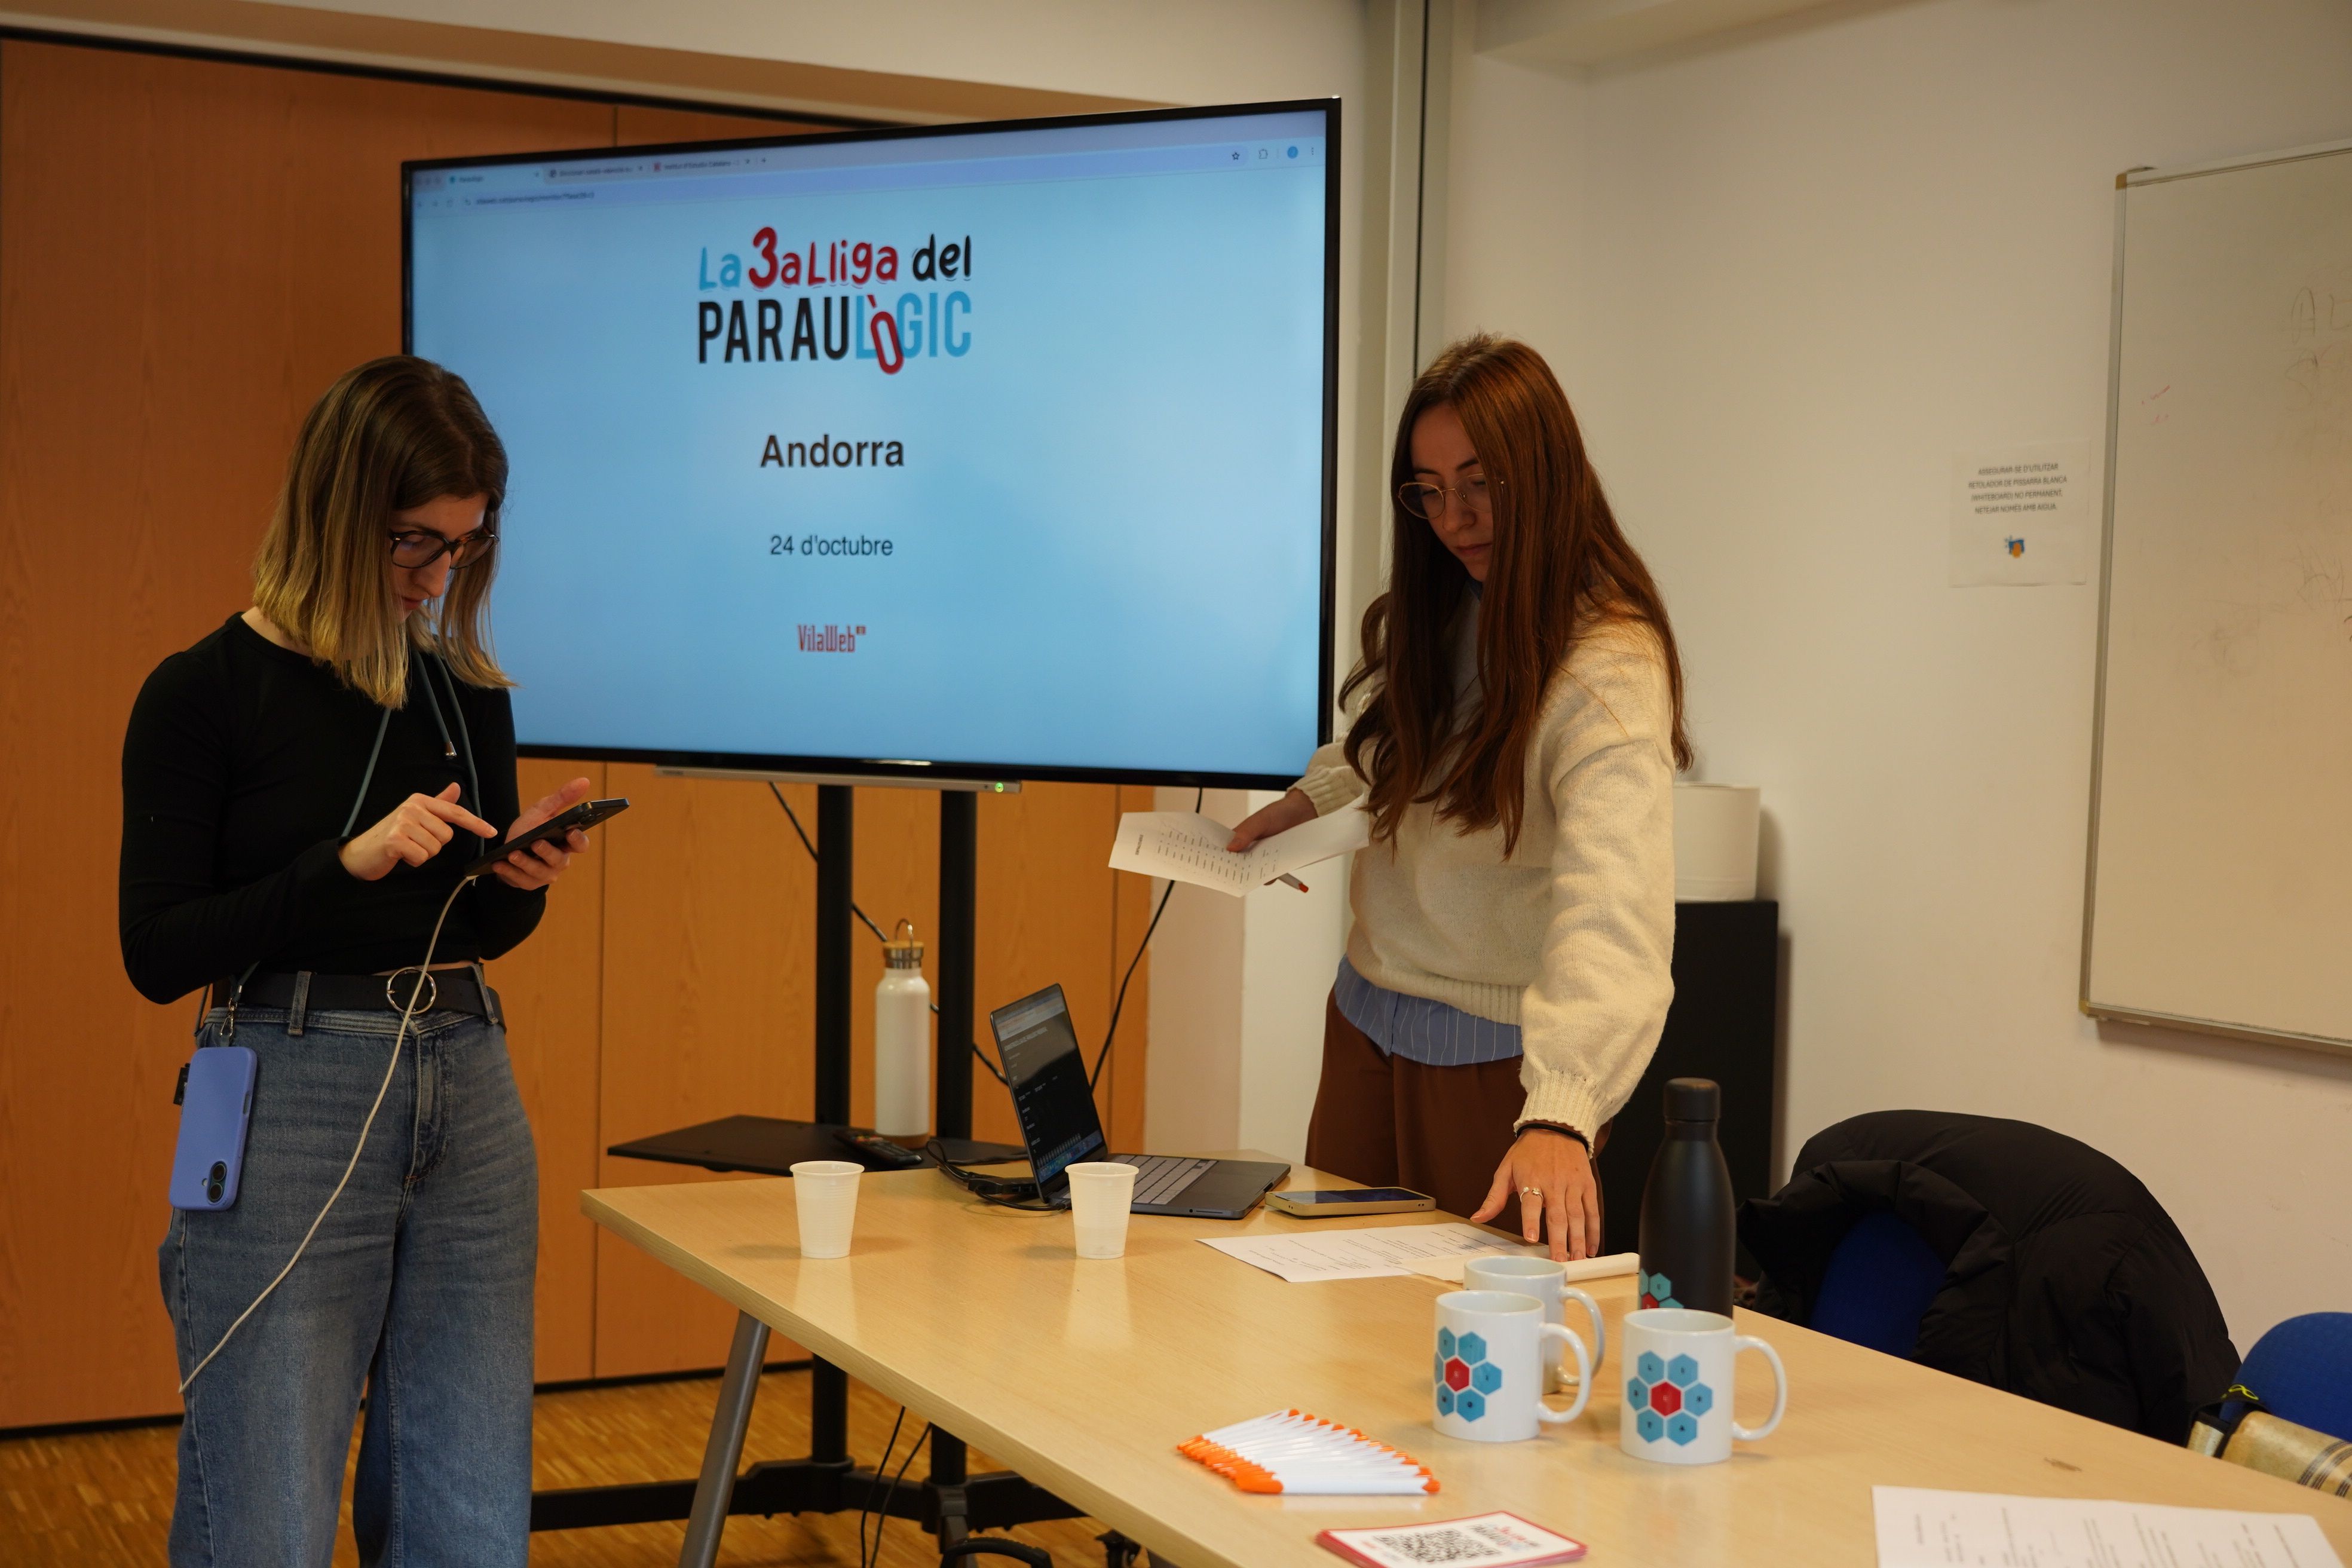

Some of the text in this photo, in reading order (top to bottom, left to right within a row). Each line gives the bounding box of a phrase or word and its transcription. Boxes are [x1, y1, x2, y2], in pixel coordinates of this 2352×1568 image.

[699, 247, 742, 290] La
[912, 233, 972, 281] del
[699, 291, 972, 375] PARAULÒGIC
[760, 434, 905, 468] Andorra
[770, 535, 893, 556] 24 d'octubre
[797, 624, 856, 653] VilaWeb
